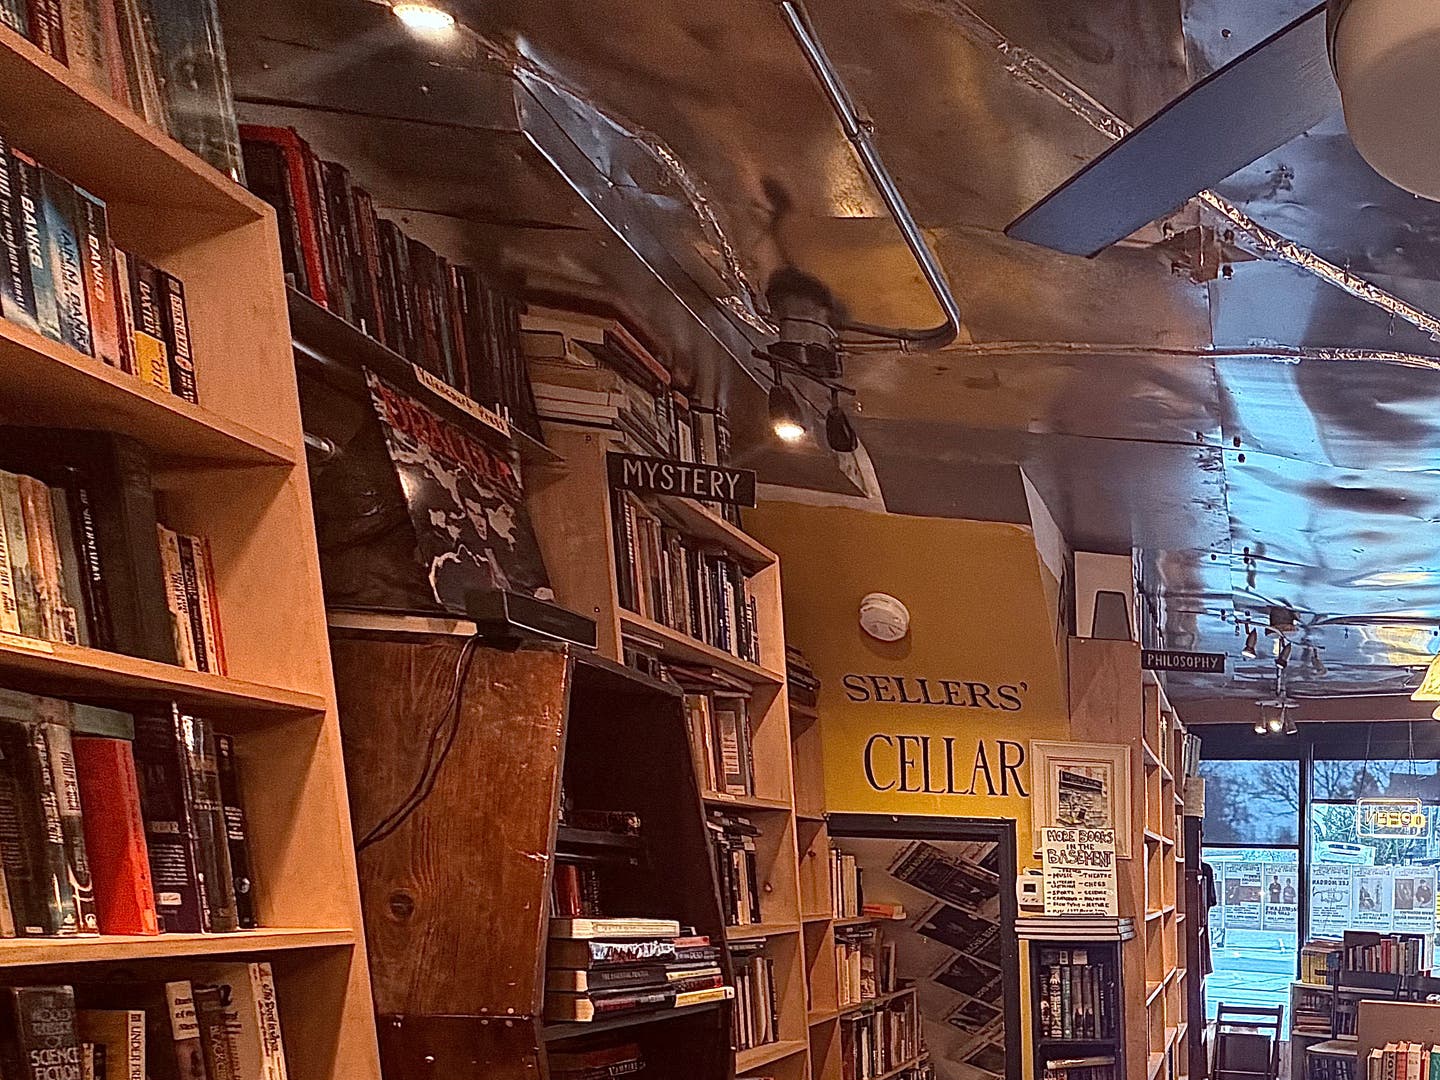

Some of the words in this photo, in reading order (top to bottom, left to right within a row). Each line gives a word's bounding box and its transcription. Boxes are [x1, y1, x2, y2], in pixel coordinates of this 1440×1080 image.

[21, 195, 44, 270] BANKS
[623, 458, 740, 499] MYSTERY
[1147, 653, 1218, 669] PHILOSOPHY
[842, 674, 1028, 711] SELLERS'
[863, 733, 1029, 797] CELLAR
[1047, 830, 1075, 842] MORE
[1079, 830, 1114, 844] BOOKS
[1047, 849, 1114, 868] BASEMENT
[31, 1046, 81, 1066] SCIENCE
[130, 1027, 143, 1065] UNDER
